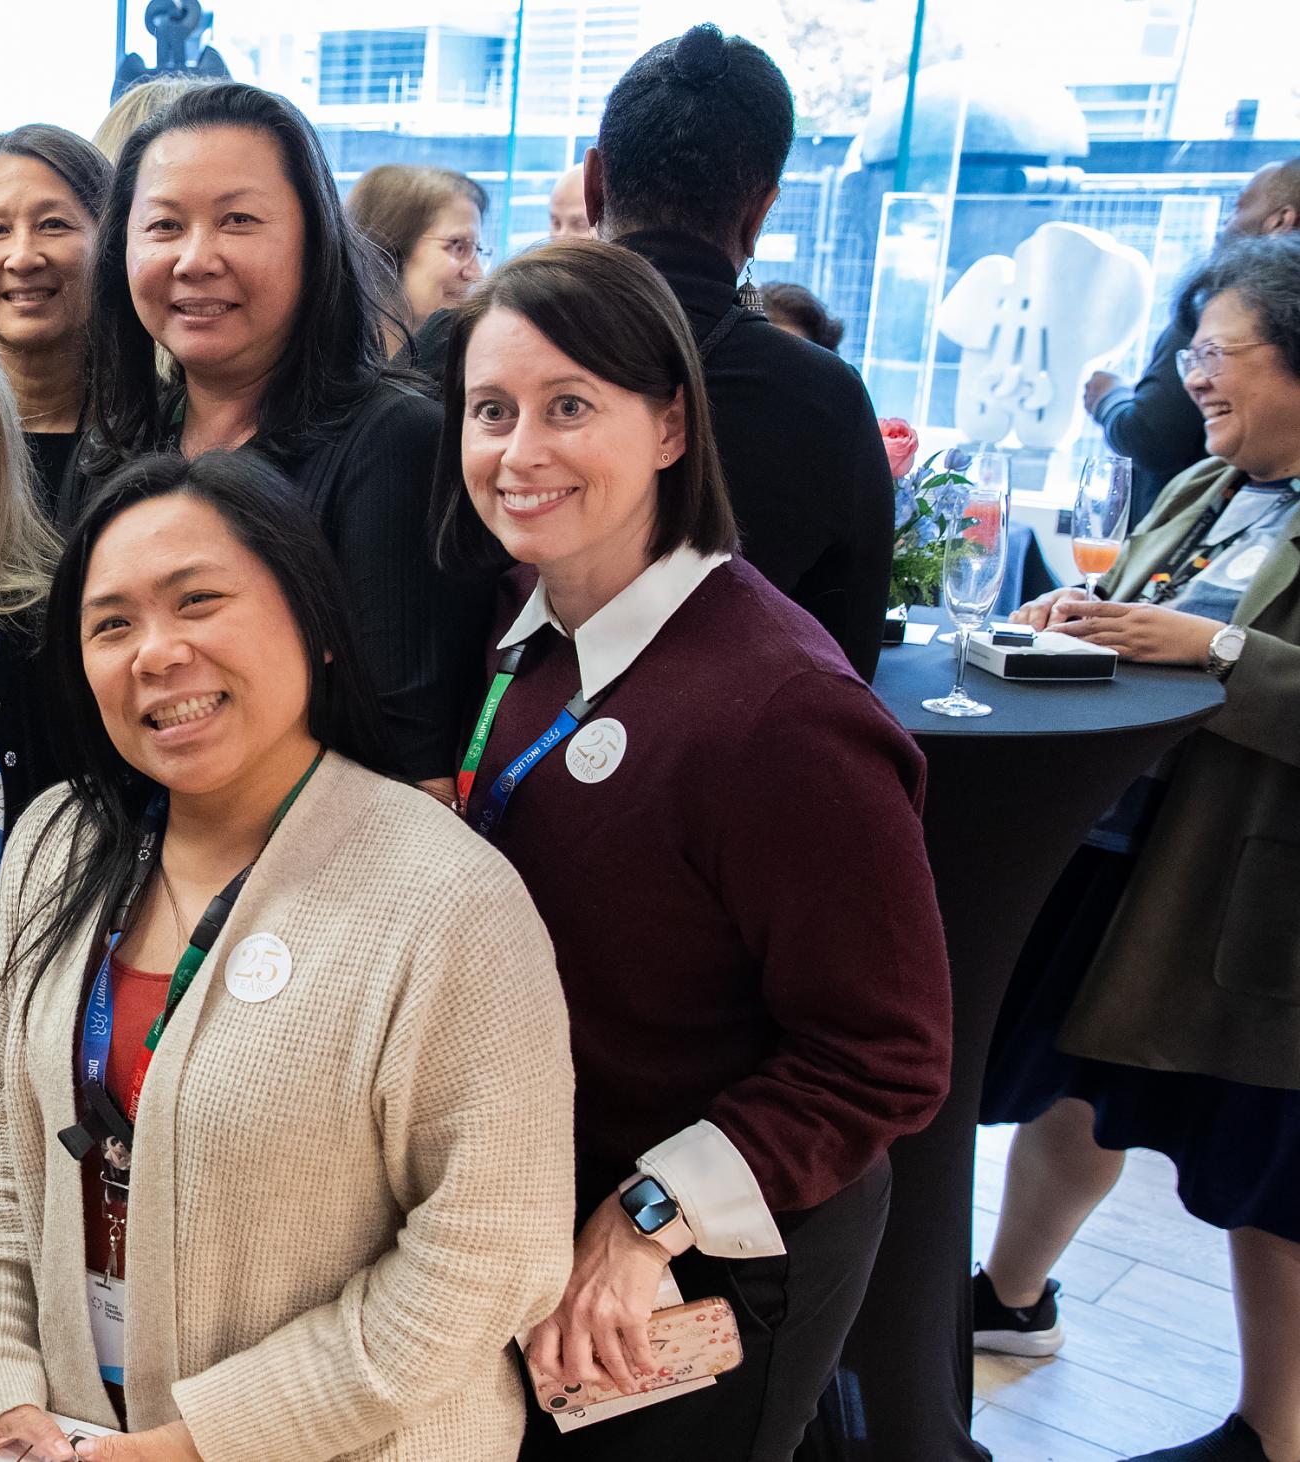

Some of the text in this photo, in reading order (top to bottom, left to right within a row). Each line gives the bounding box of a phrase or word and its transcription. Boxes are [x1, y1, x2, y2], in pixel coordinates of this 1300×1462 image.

[476, 698, 498, 740] HUMANITY
[507, 746, 541, 778] INCLUSI
[570, 751, 597, 780] YEARS
[576, 729, 618, 770] 25
[234, 947, 282, 983] 25
[232, 976, 271, 994] YEARS
[128, 1090, 141, 1123] ERVICE
